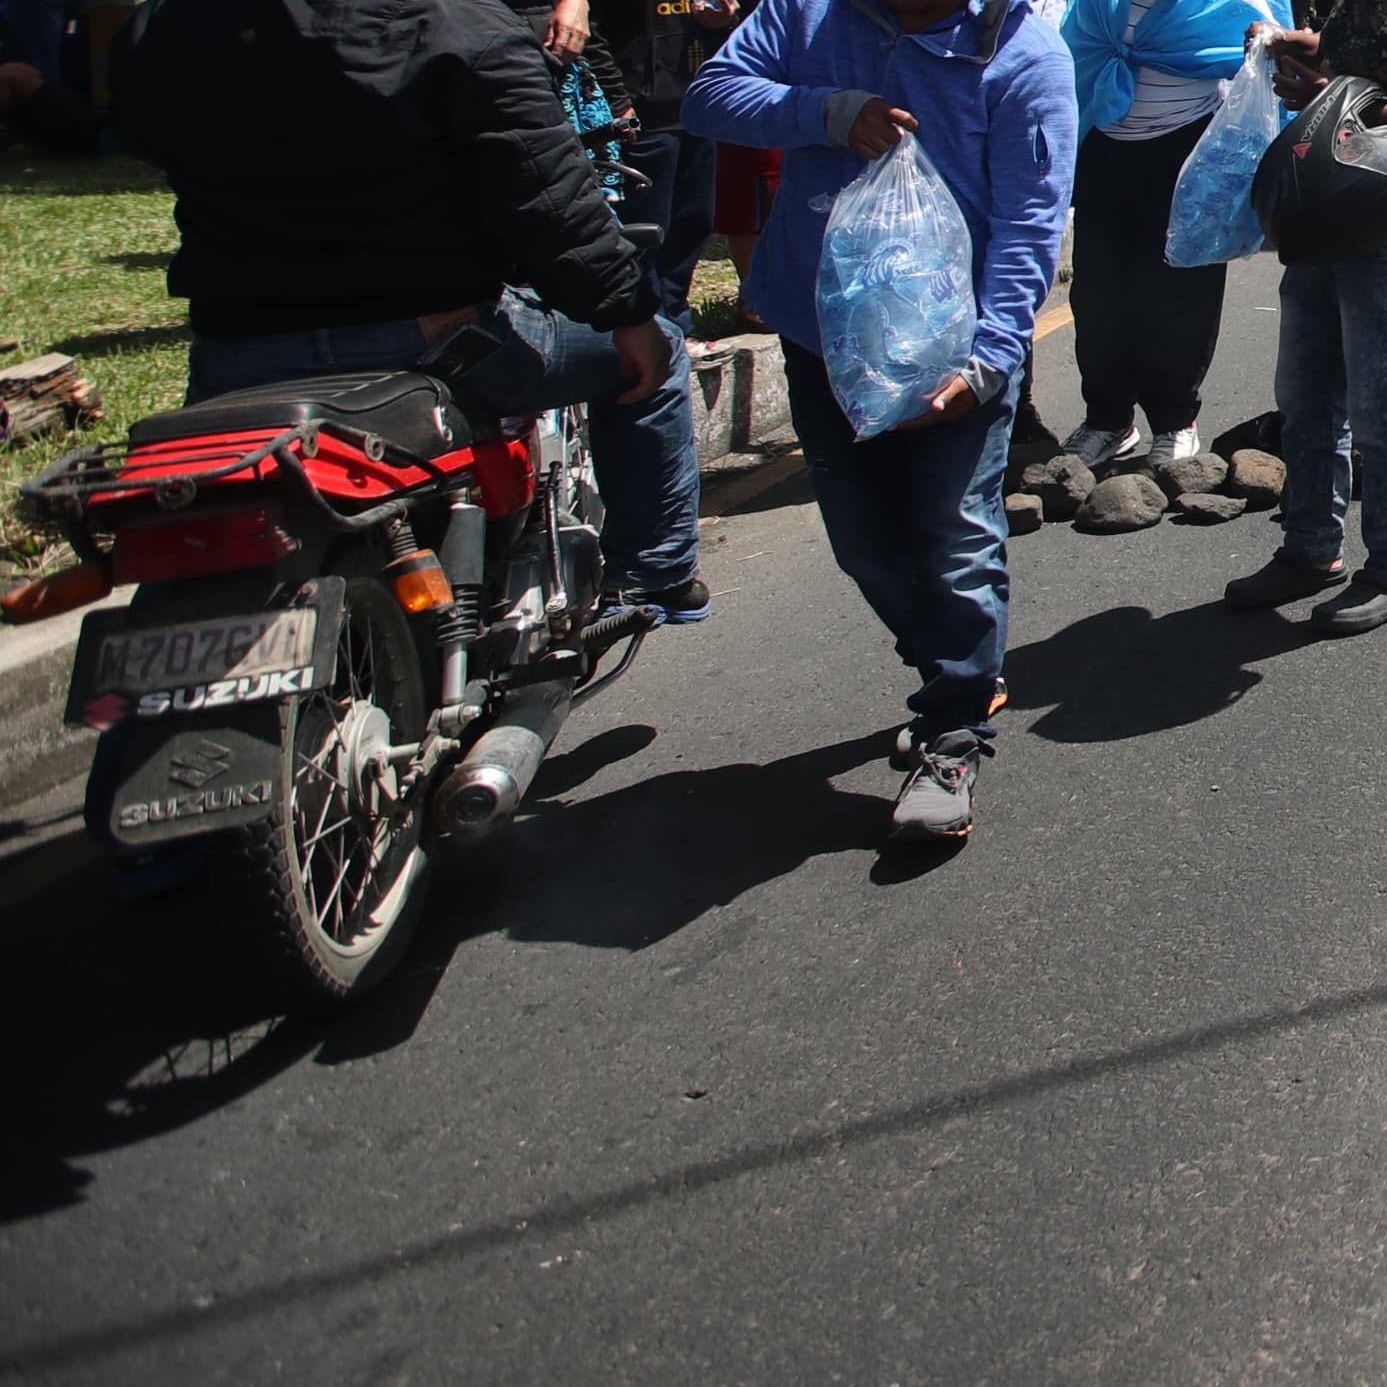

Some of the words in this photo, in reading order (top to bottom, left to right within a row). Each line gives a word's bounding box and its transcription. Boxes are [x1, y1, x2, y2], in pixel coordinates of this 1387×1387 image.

[657, 0, 693, 15] adi
[138, 667, 315, 715] SUZUKI
[119, 780, 273, 829] SUZUKI
